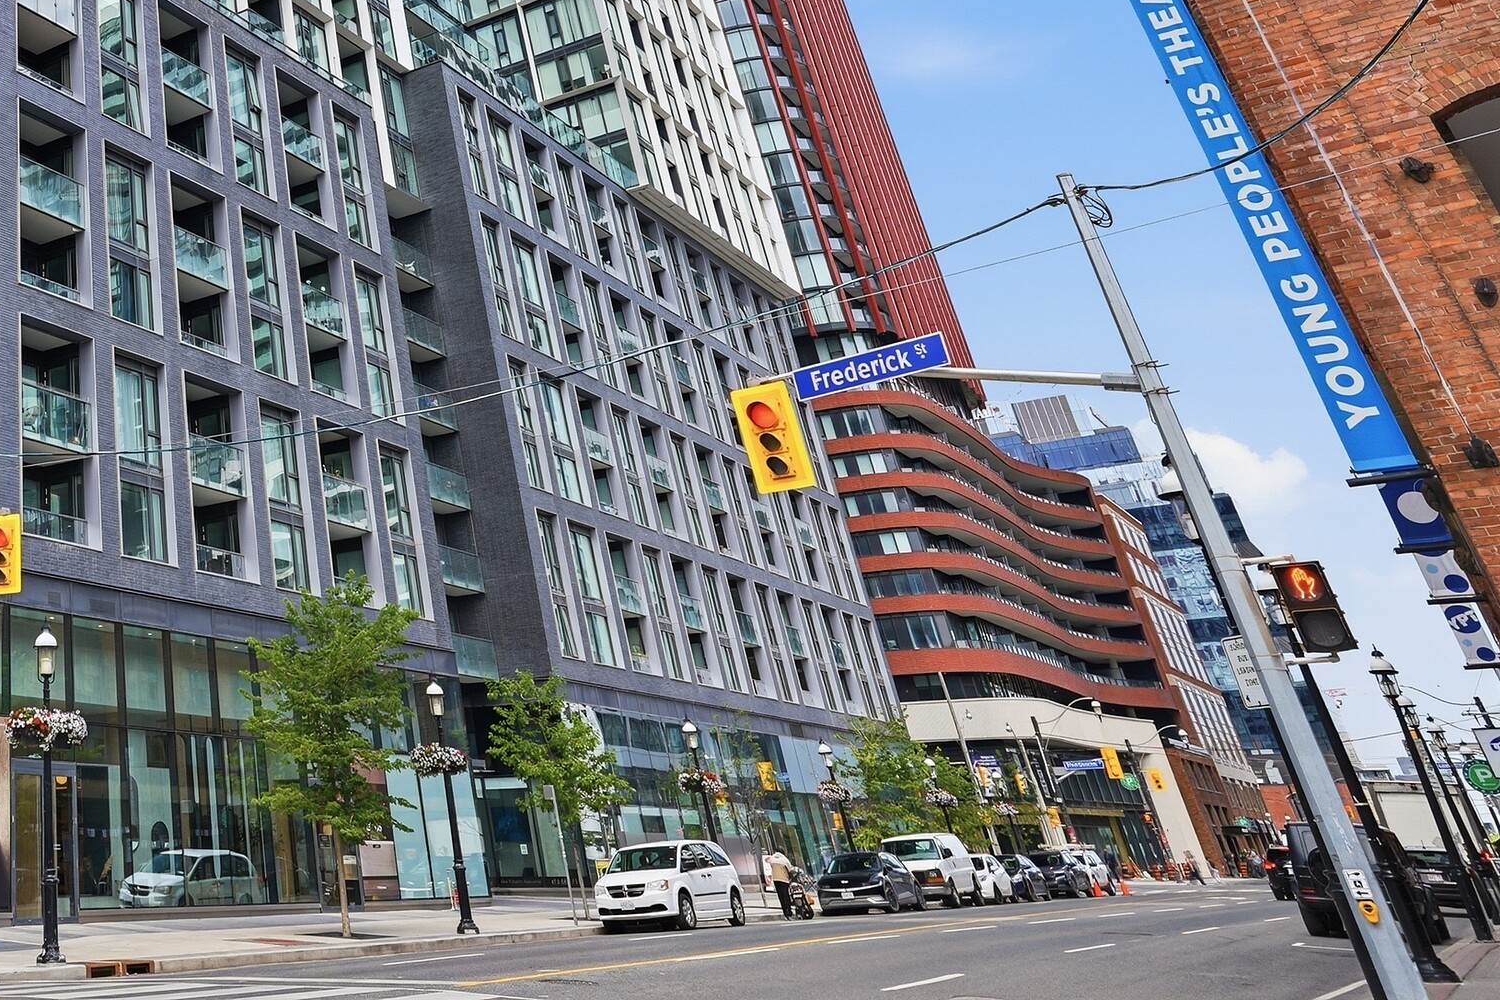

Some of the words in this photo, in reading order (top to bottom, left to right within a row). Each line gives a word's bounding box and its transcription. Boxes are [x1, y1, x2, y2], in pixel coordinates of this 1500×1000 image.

[1187, 82, 1302, 262] PEOPLE'S
[810, 350, 912, 391] Frederick
[914, 343, 928, 357] St
[1280, 272, 1380, 430] YOUNG
[1449, 610, 1479, 629] YPT
